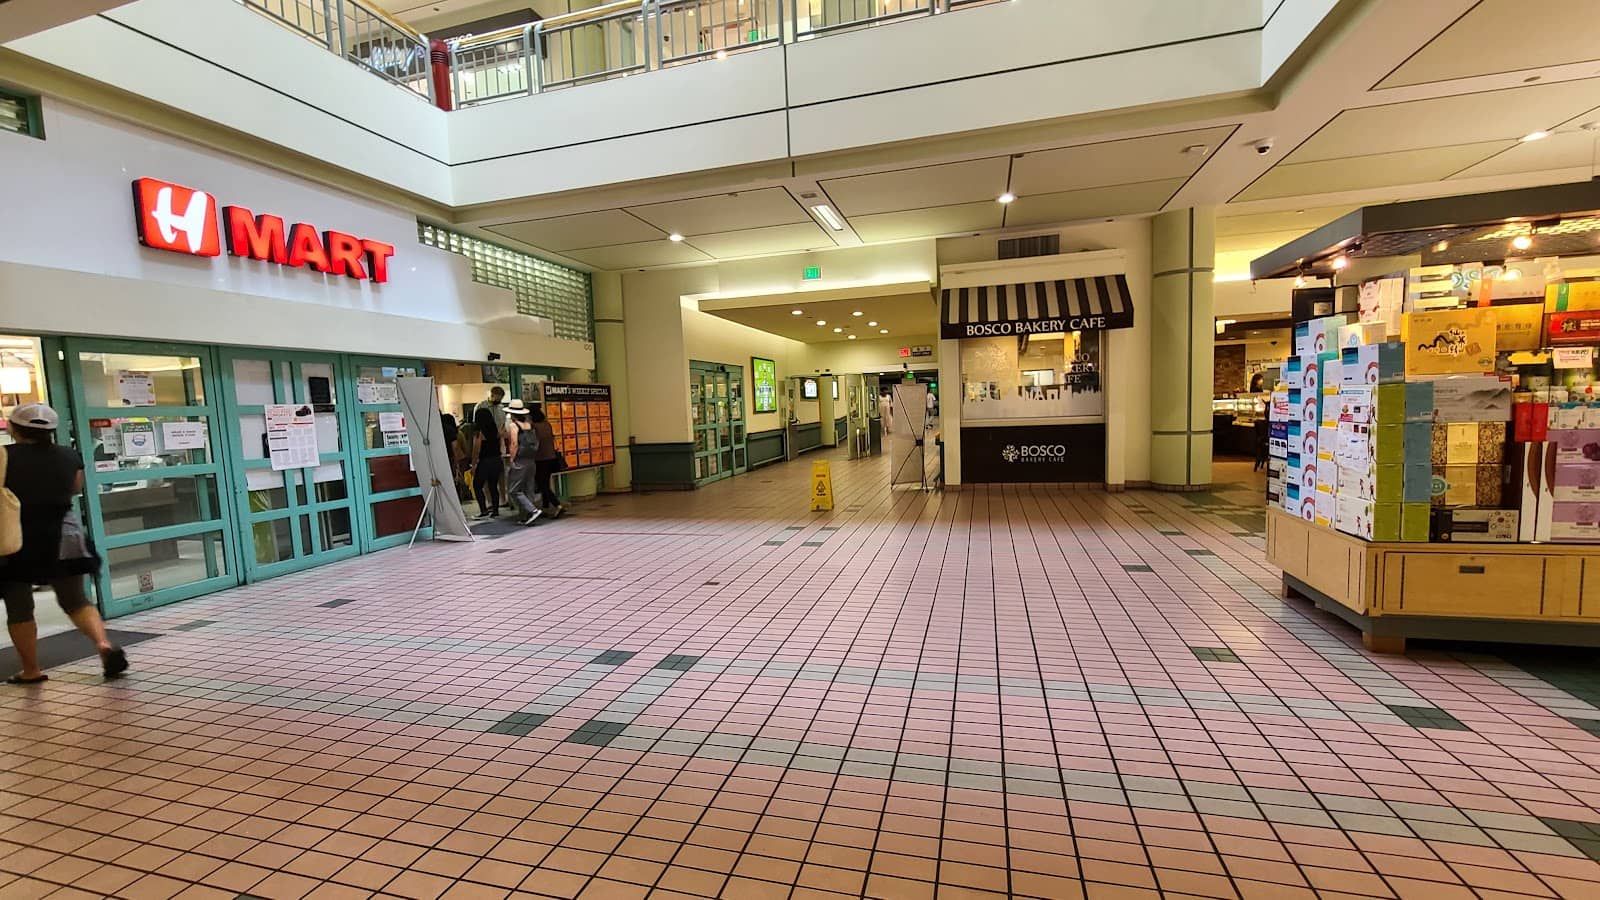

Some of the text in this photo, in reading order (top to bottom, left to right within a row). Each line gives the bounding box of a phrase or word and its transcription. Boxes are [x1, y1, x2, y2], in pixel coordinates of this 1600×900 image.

[151, 186, 395, 283] H MART
[966, 316, 1106, 337] BOSCO BAKERY CAFE
[1020, 444, 1066, 457] BOSCO
